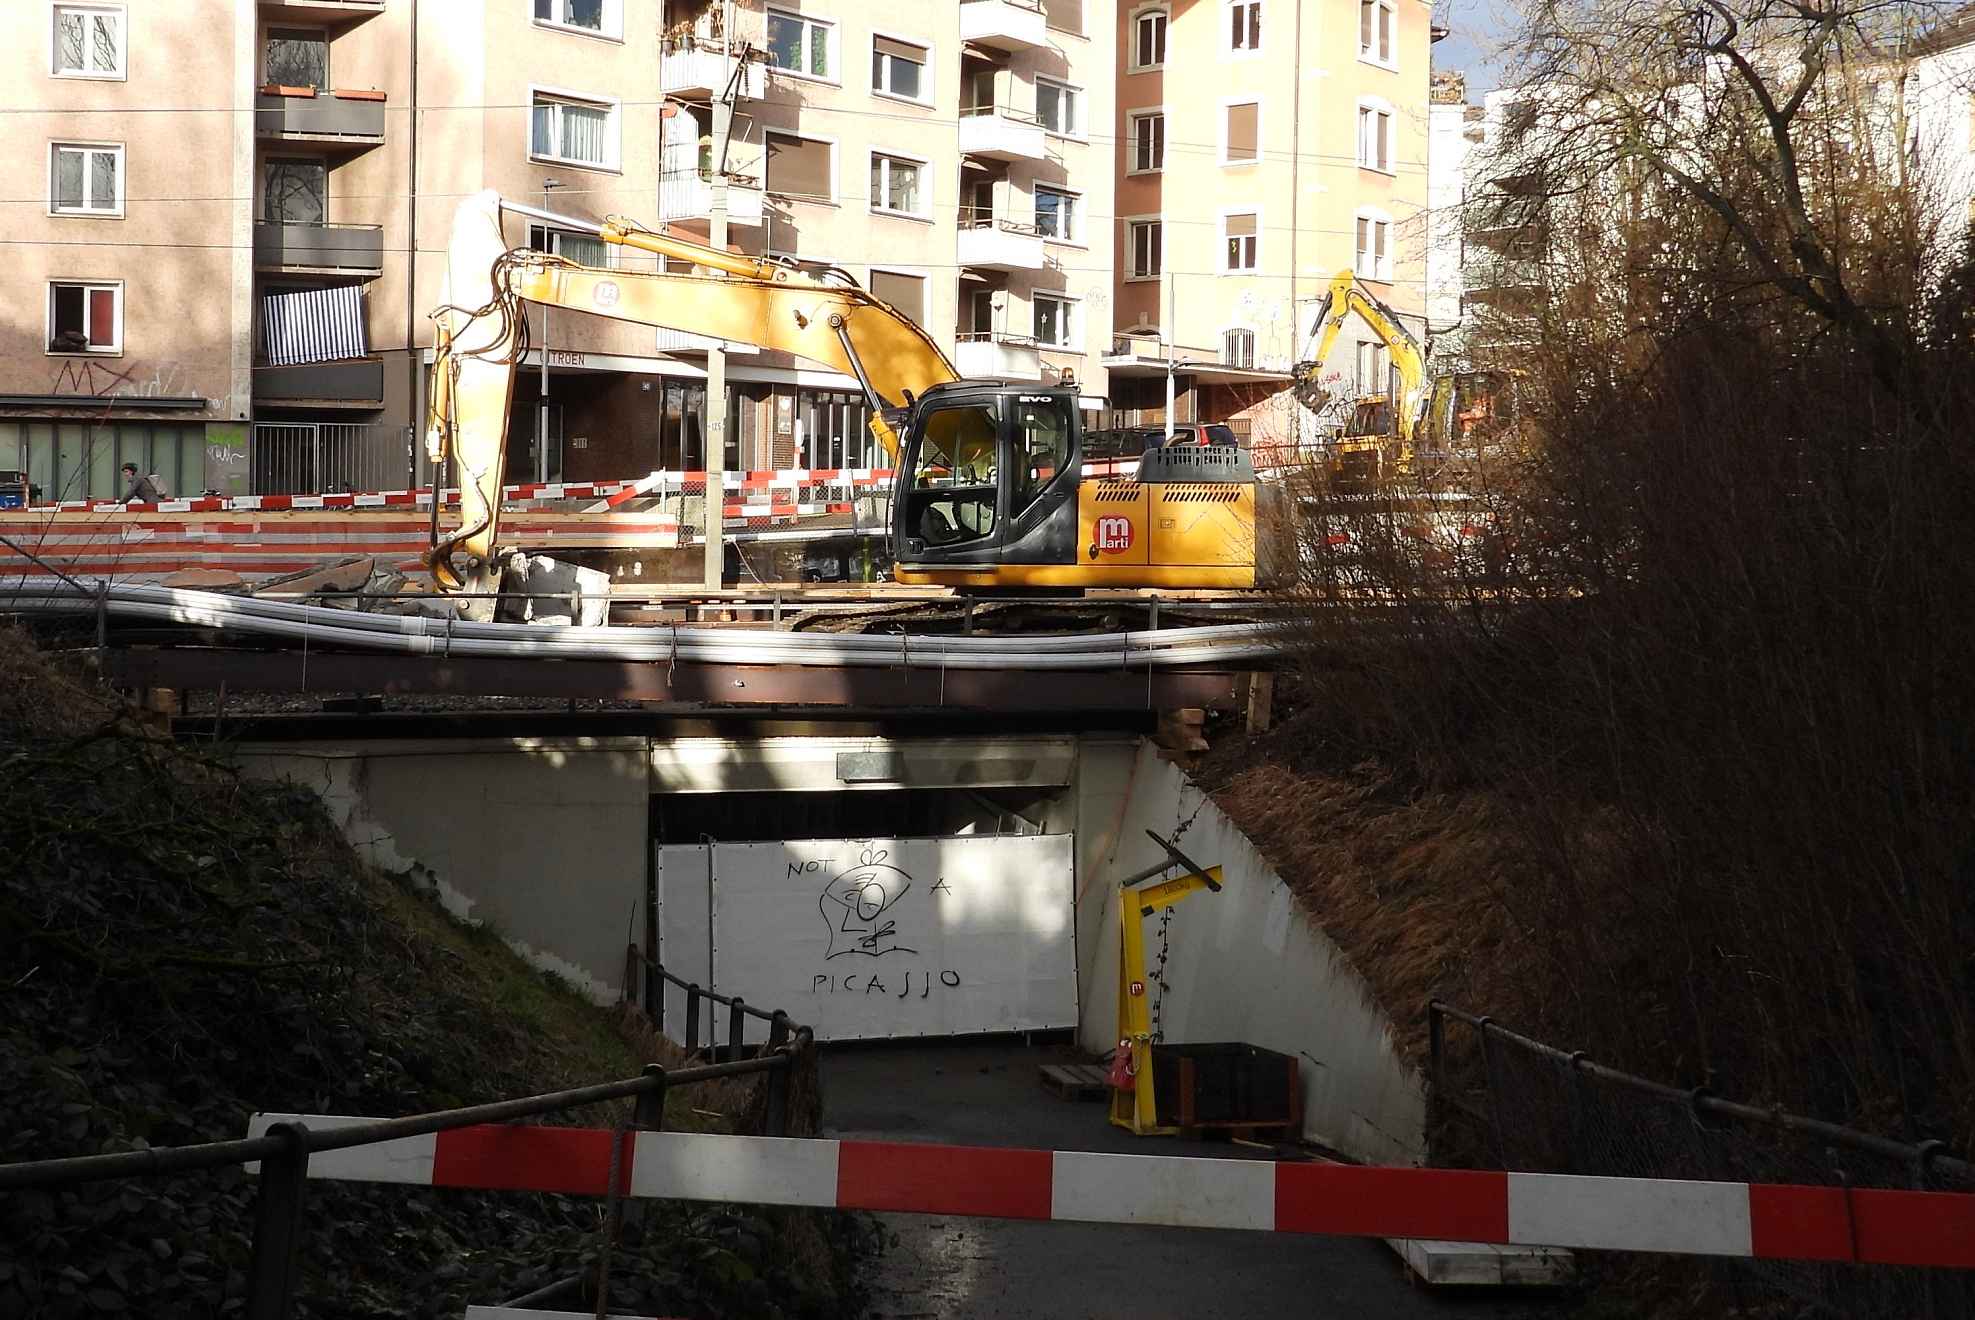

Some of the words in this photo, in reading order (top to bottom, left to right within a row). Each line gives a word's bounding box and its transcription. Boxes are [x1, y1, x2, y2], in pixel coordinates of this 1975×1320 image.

[1019, 395, 1053, 403] EVO
[787, 859, 836, 880] NOT
[929, 877, 952, 896] A
